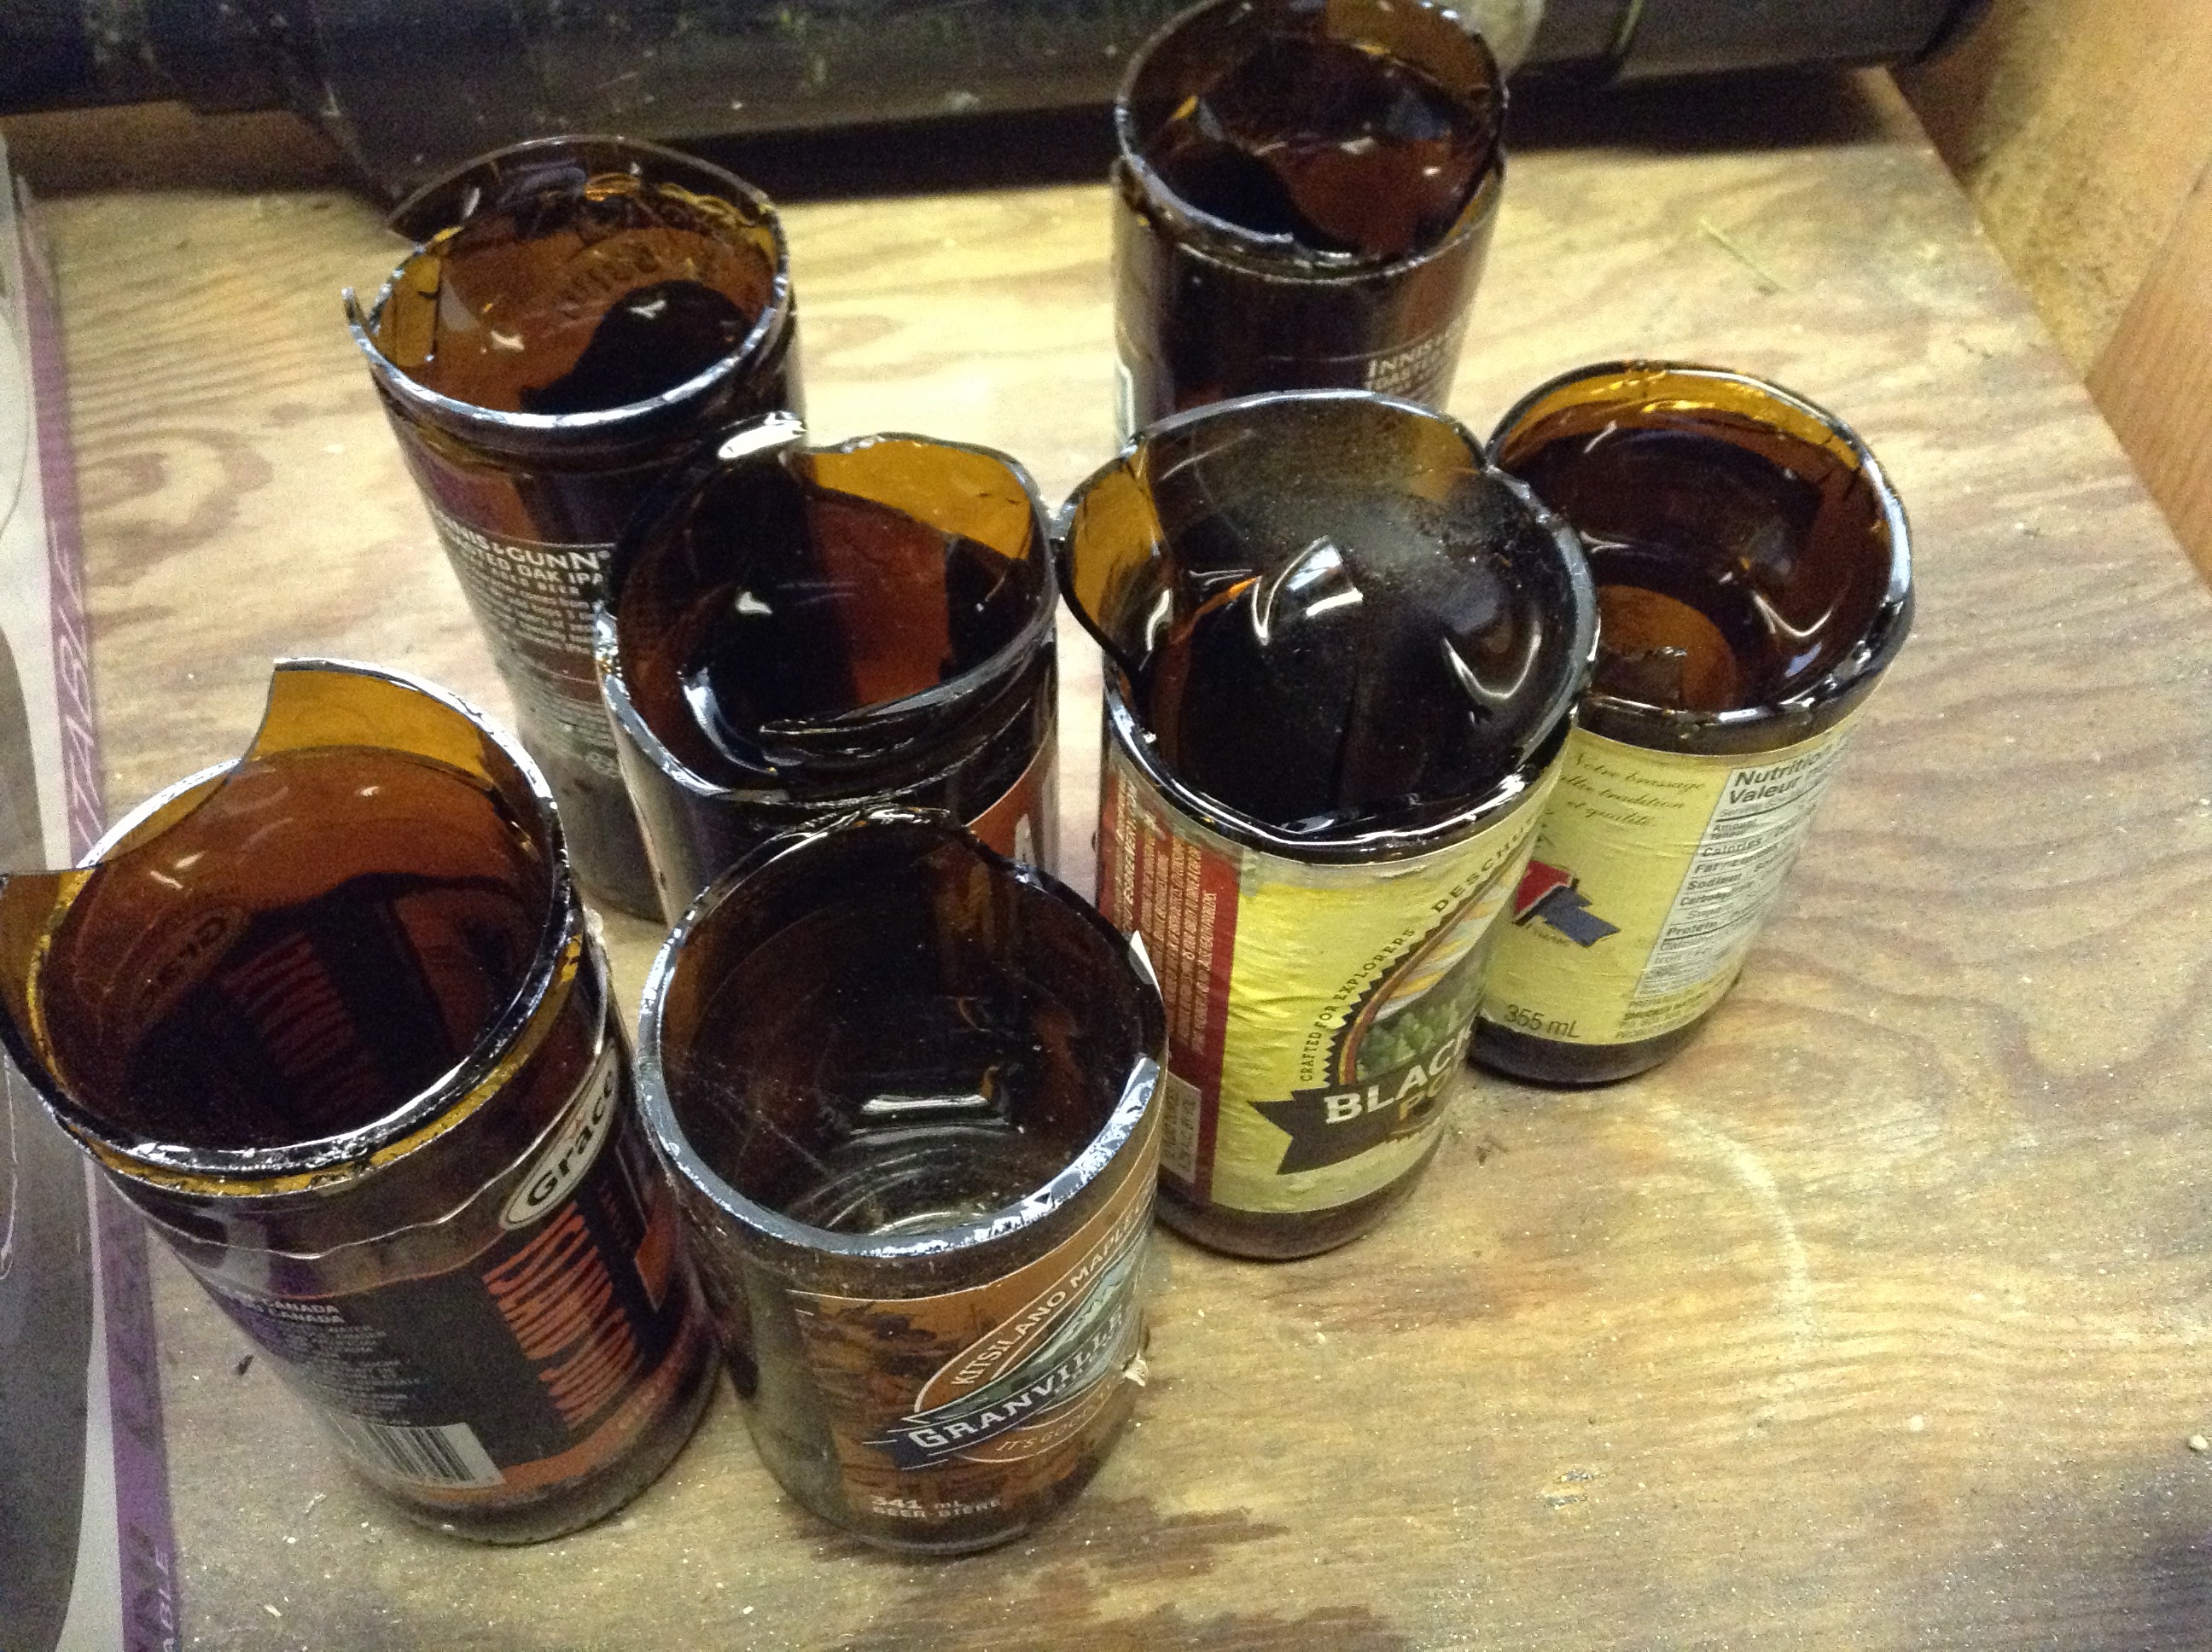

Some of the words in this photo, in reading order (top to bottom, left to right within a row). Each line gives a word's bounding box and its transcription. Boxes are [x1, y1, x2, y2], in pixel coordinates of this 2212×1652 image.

[505, 546, 599, 570] GUNN
[1729, 776, 1802, 805] Valeur
[1300, 1031, 1322, 1082] CRAFTED
[1314, 1004, 1339, 1029] FOR
[1333, 929, 1416, 1001] EXPLORERS
[1504, 1003, 1545, 1031] 355
[1546, 1019, 1580, 1038] mL
[1323, 1023, 1472, 1125] BLACK
[951, 1290, 1066, 1386] KITSILANO
